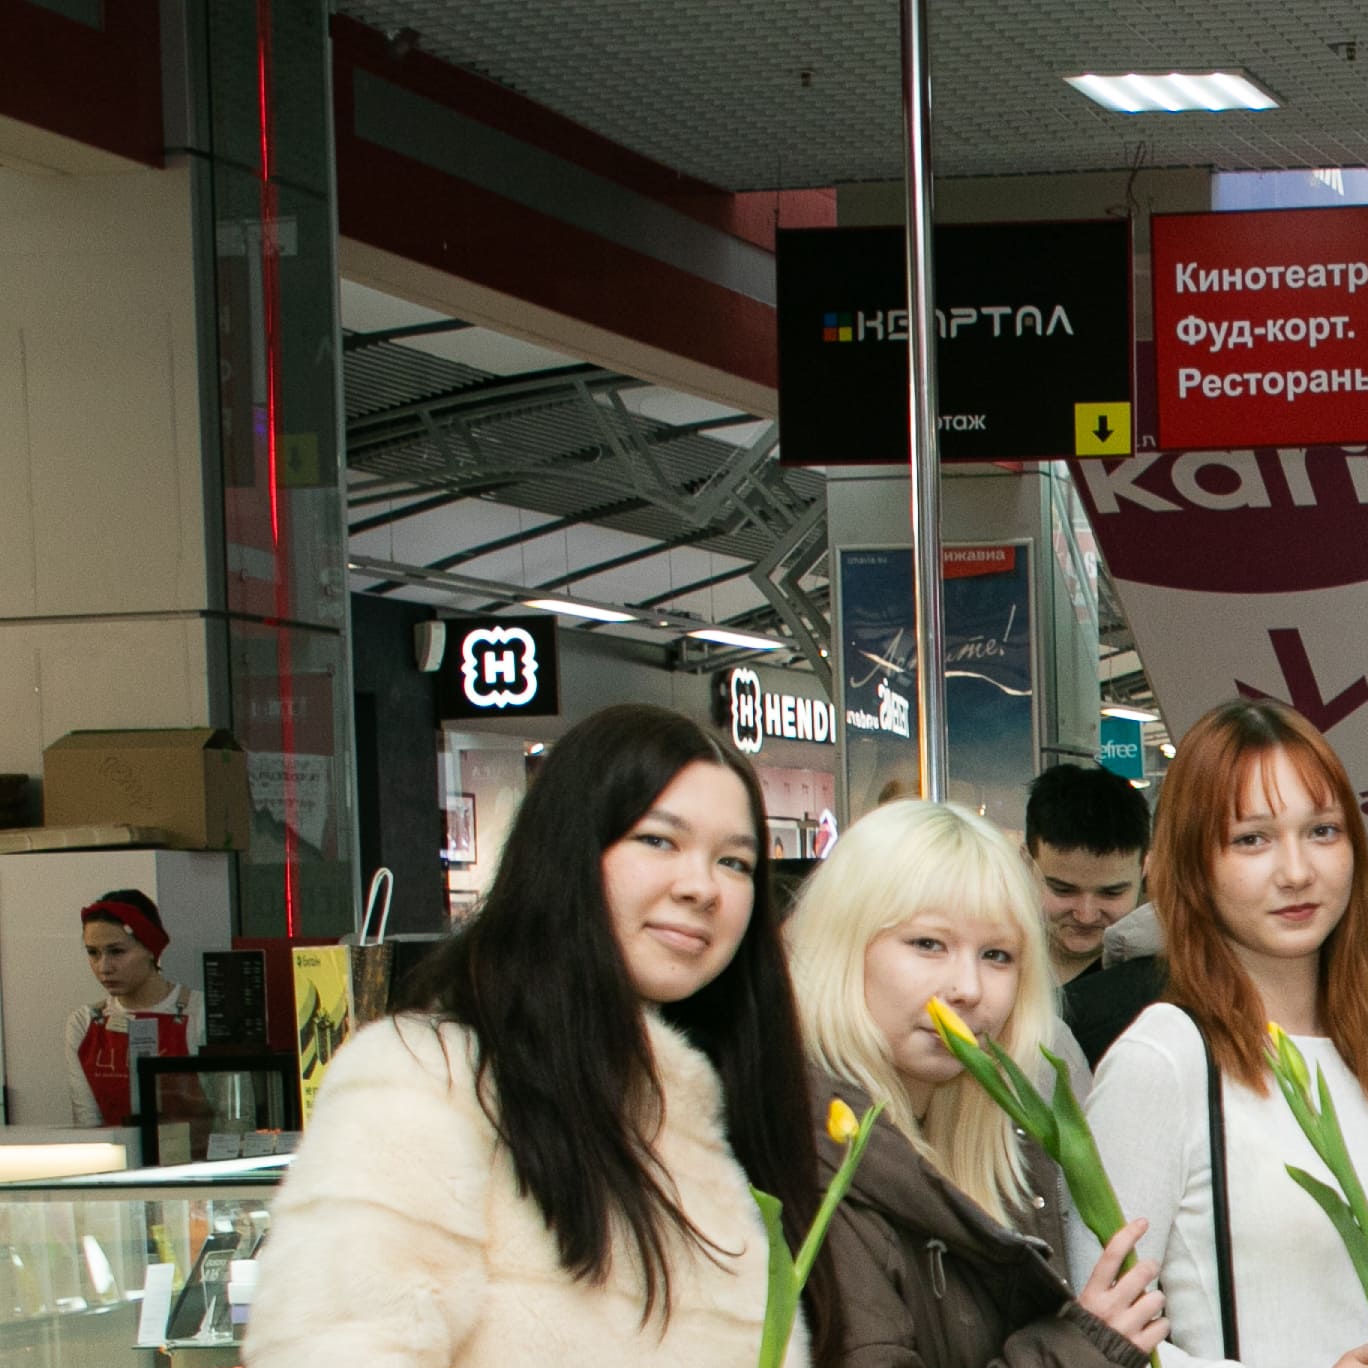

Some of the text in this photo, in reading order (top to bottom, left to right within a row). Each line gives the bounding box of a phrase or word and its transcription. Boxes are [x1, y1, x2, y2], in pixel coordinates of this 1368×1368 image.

[1175, 315, 1355, 352] Фуд-корт.
[483, 650, 515, 684] H
[739, 694, 755, 727] H
